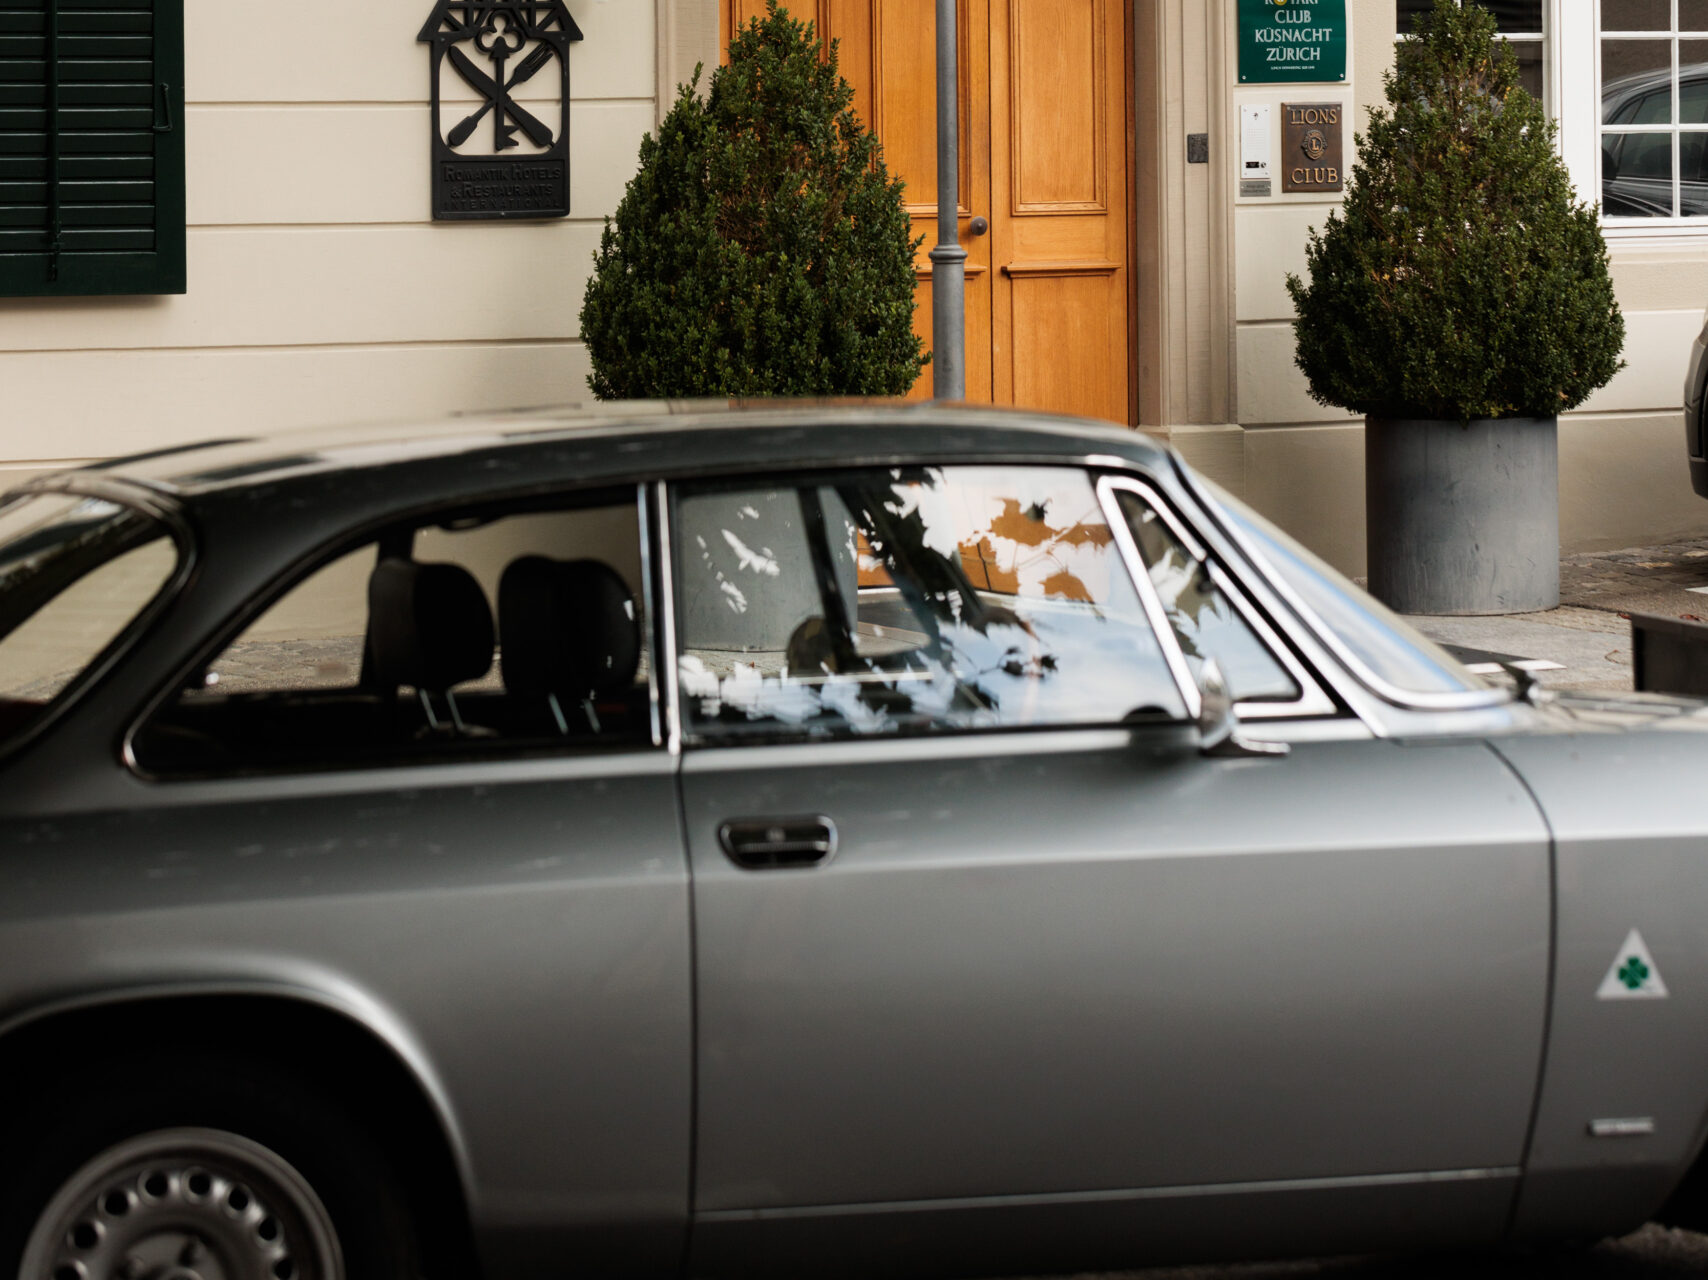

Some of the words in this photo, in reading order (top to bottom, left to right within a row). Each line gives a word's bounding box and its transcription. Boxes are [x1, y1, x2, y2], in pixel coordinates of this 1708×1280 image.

[1275, 9, 1312, 24] CLUB
[1255, 27, 1333, 43] KÜSNACHT
[1266, 46, 1321, 62] ZÜRICH
[1290, 108, 1338, 125] LIONS
[444, 165, 508, 182] ROMANTIK
[511, 163, 561, 181] HOTELS
[1291, 167, 1339, 184] CLUB
